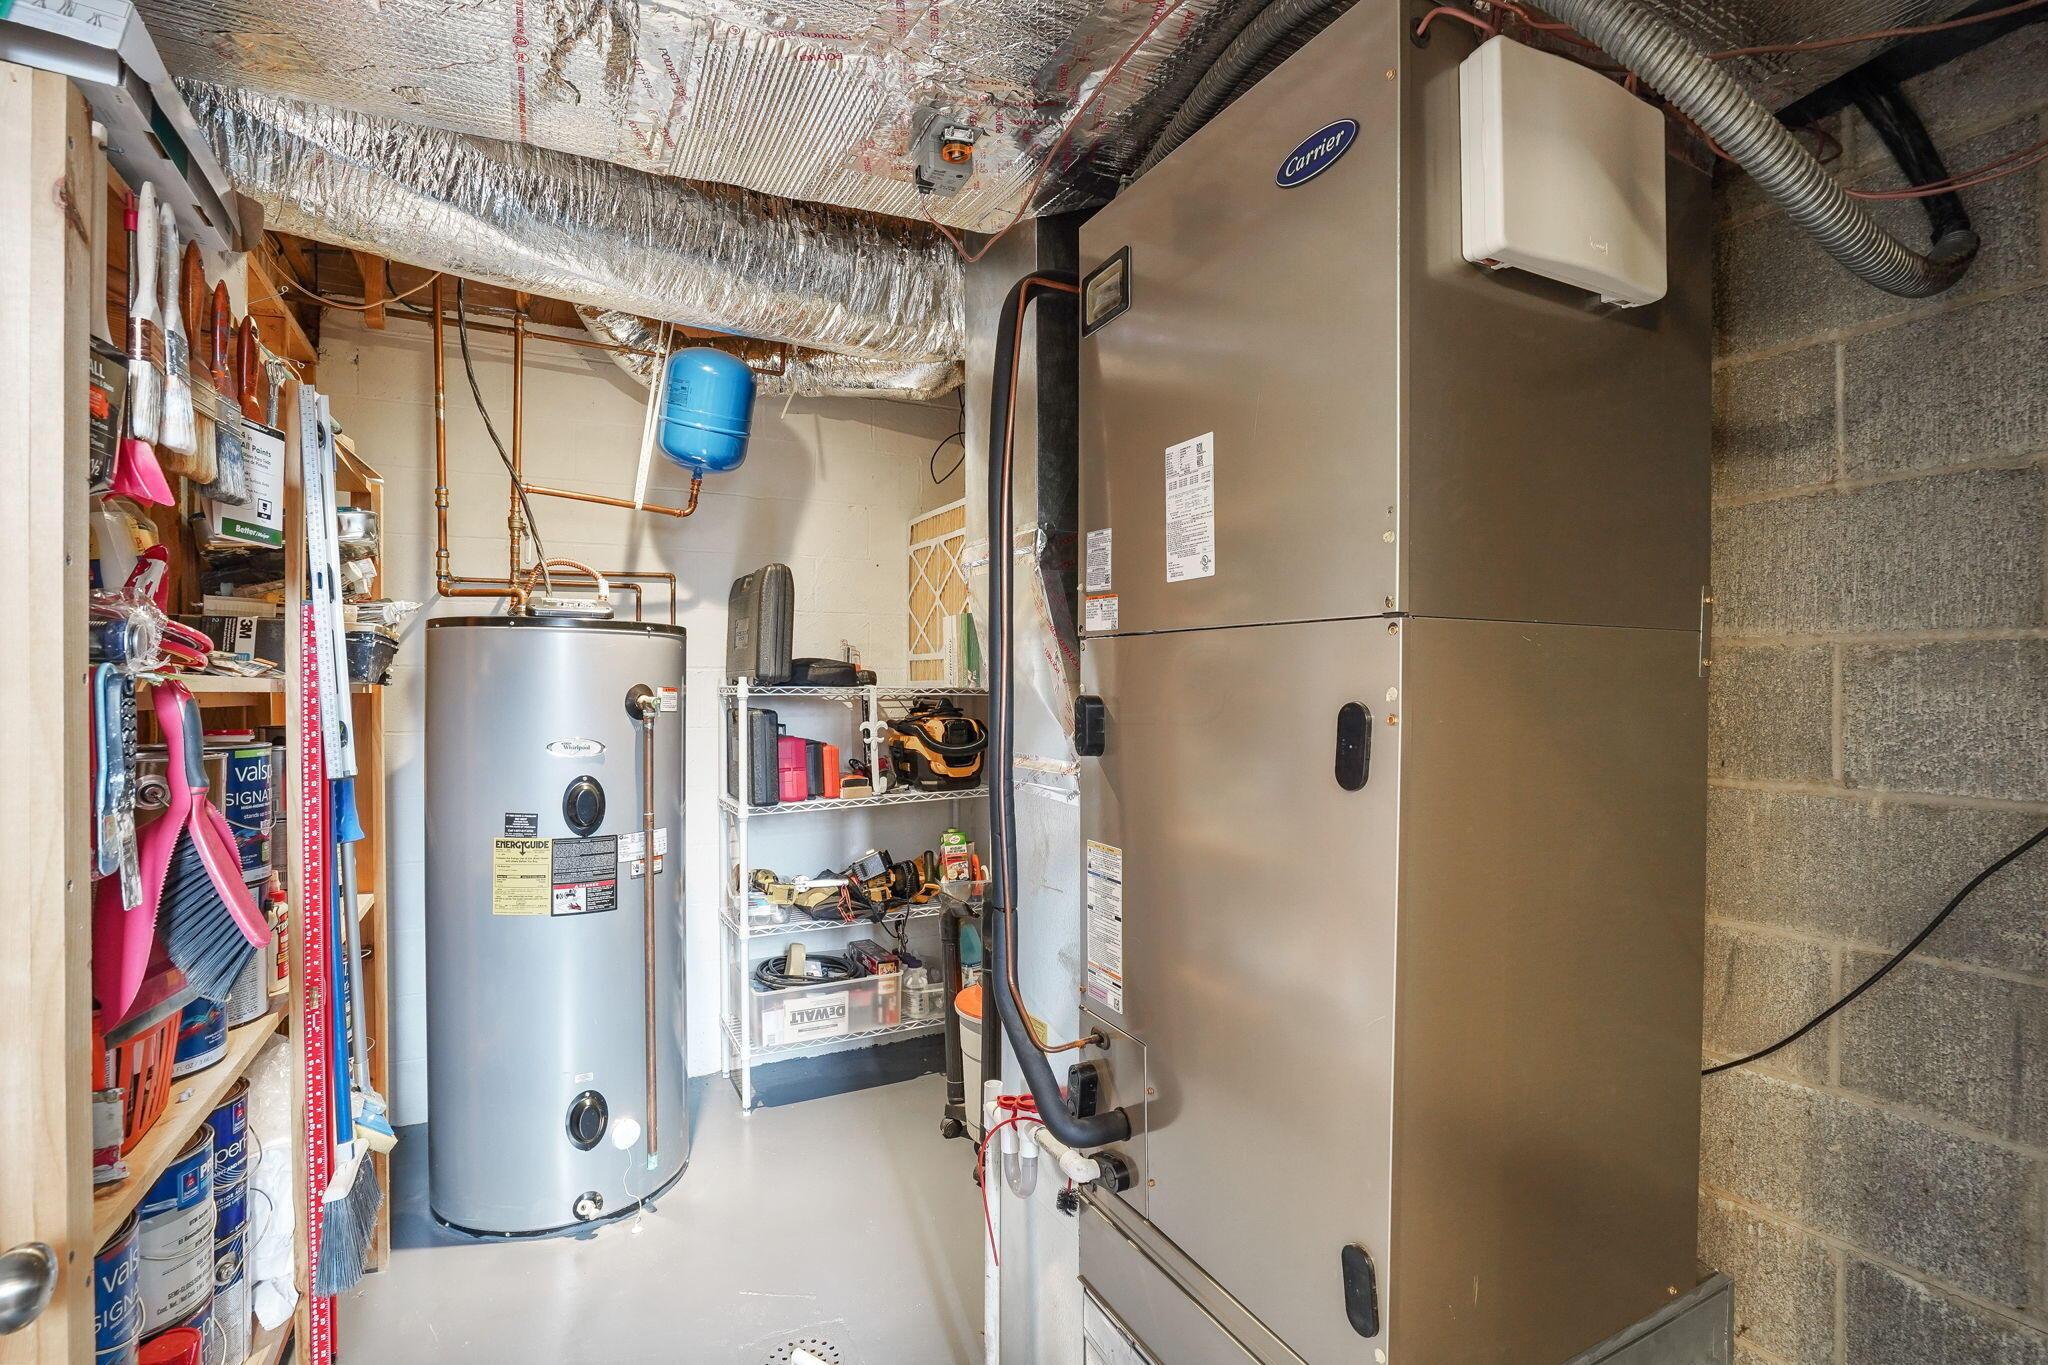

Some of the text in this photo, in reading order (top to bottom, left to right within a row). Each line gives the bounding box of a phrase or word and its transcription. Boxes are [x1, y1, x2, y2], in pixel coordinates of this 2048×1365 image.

[1285, 129, 1345, 178] Carrier
[252, 445, 272, 458] Paints
[235, 524, 257, 537] Better
[239, 619, 253, 639] 3M
